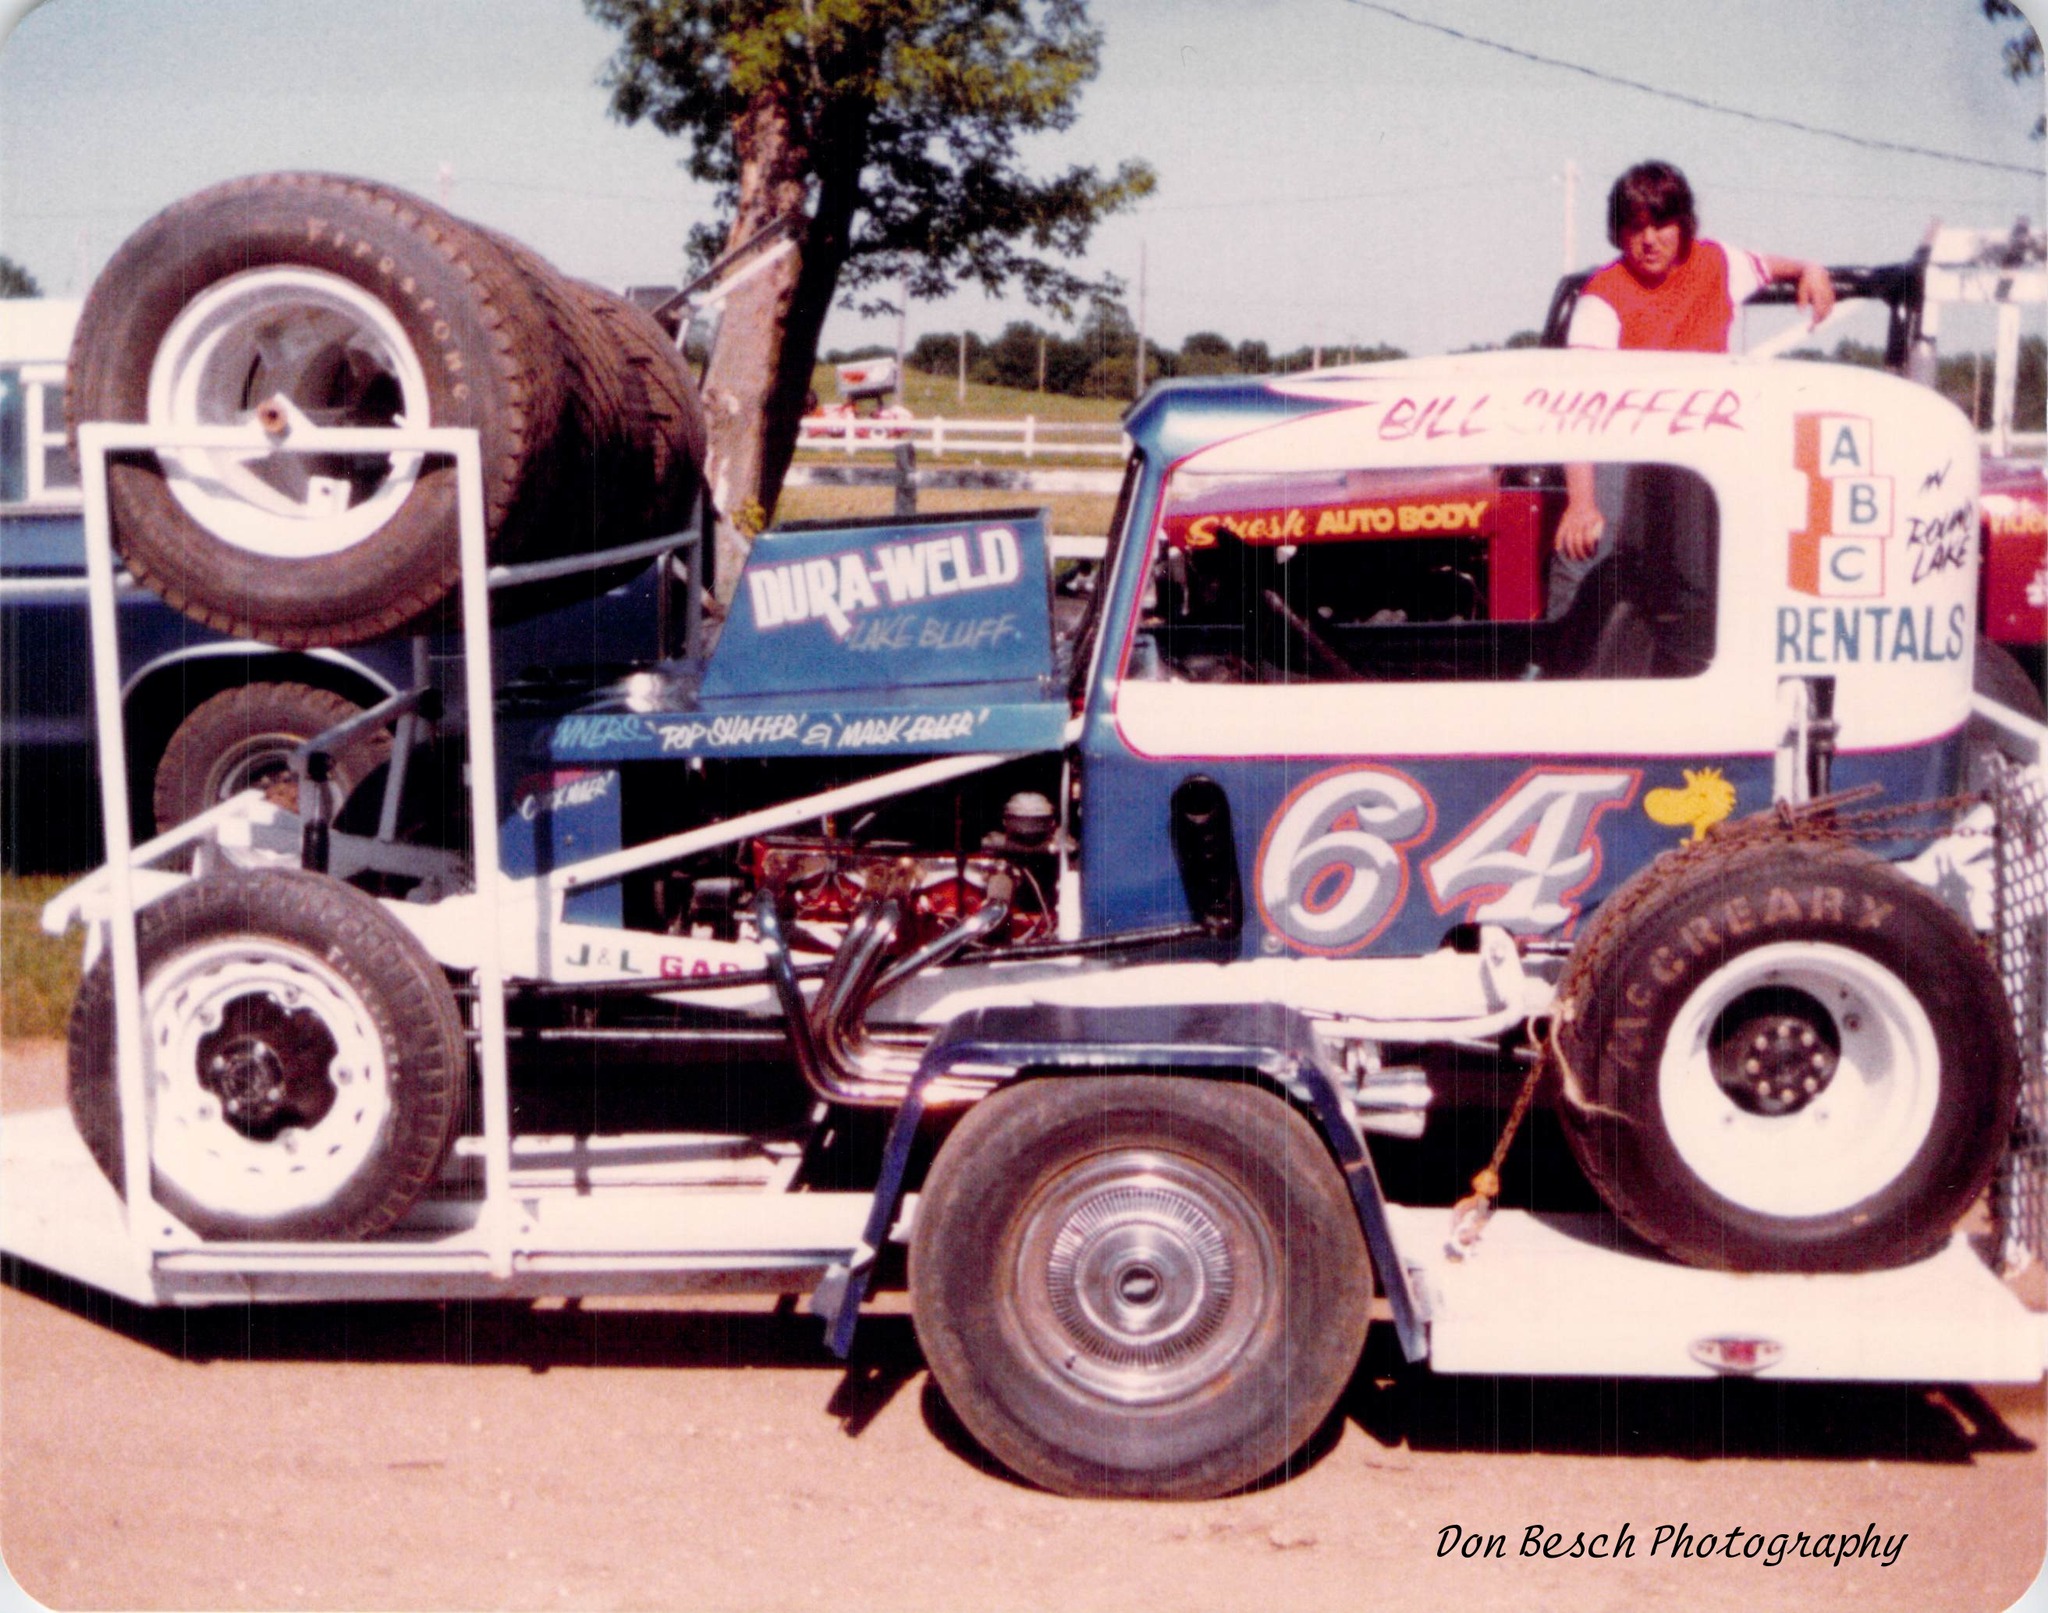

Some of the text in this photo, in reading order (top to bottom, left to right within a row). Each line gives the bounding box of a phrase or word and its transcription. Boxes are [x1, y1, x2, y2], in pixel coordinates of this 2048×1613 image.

[1378, 396, 1491, 441] BILL
[1315, 508, 1395, 535] AUTO
[1397, 500, 1489, 532] BODY
[747, 526, 1021, 638] DURA-WELD
[1910, 533, 1971, 585] LAKE
[848, 613, 918, 651] LAKE
[1775, 603, 1966, 664] RENTALS
[1253, 762, 1643, 957] 64
